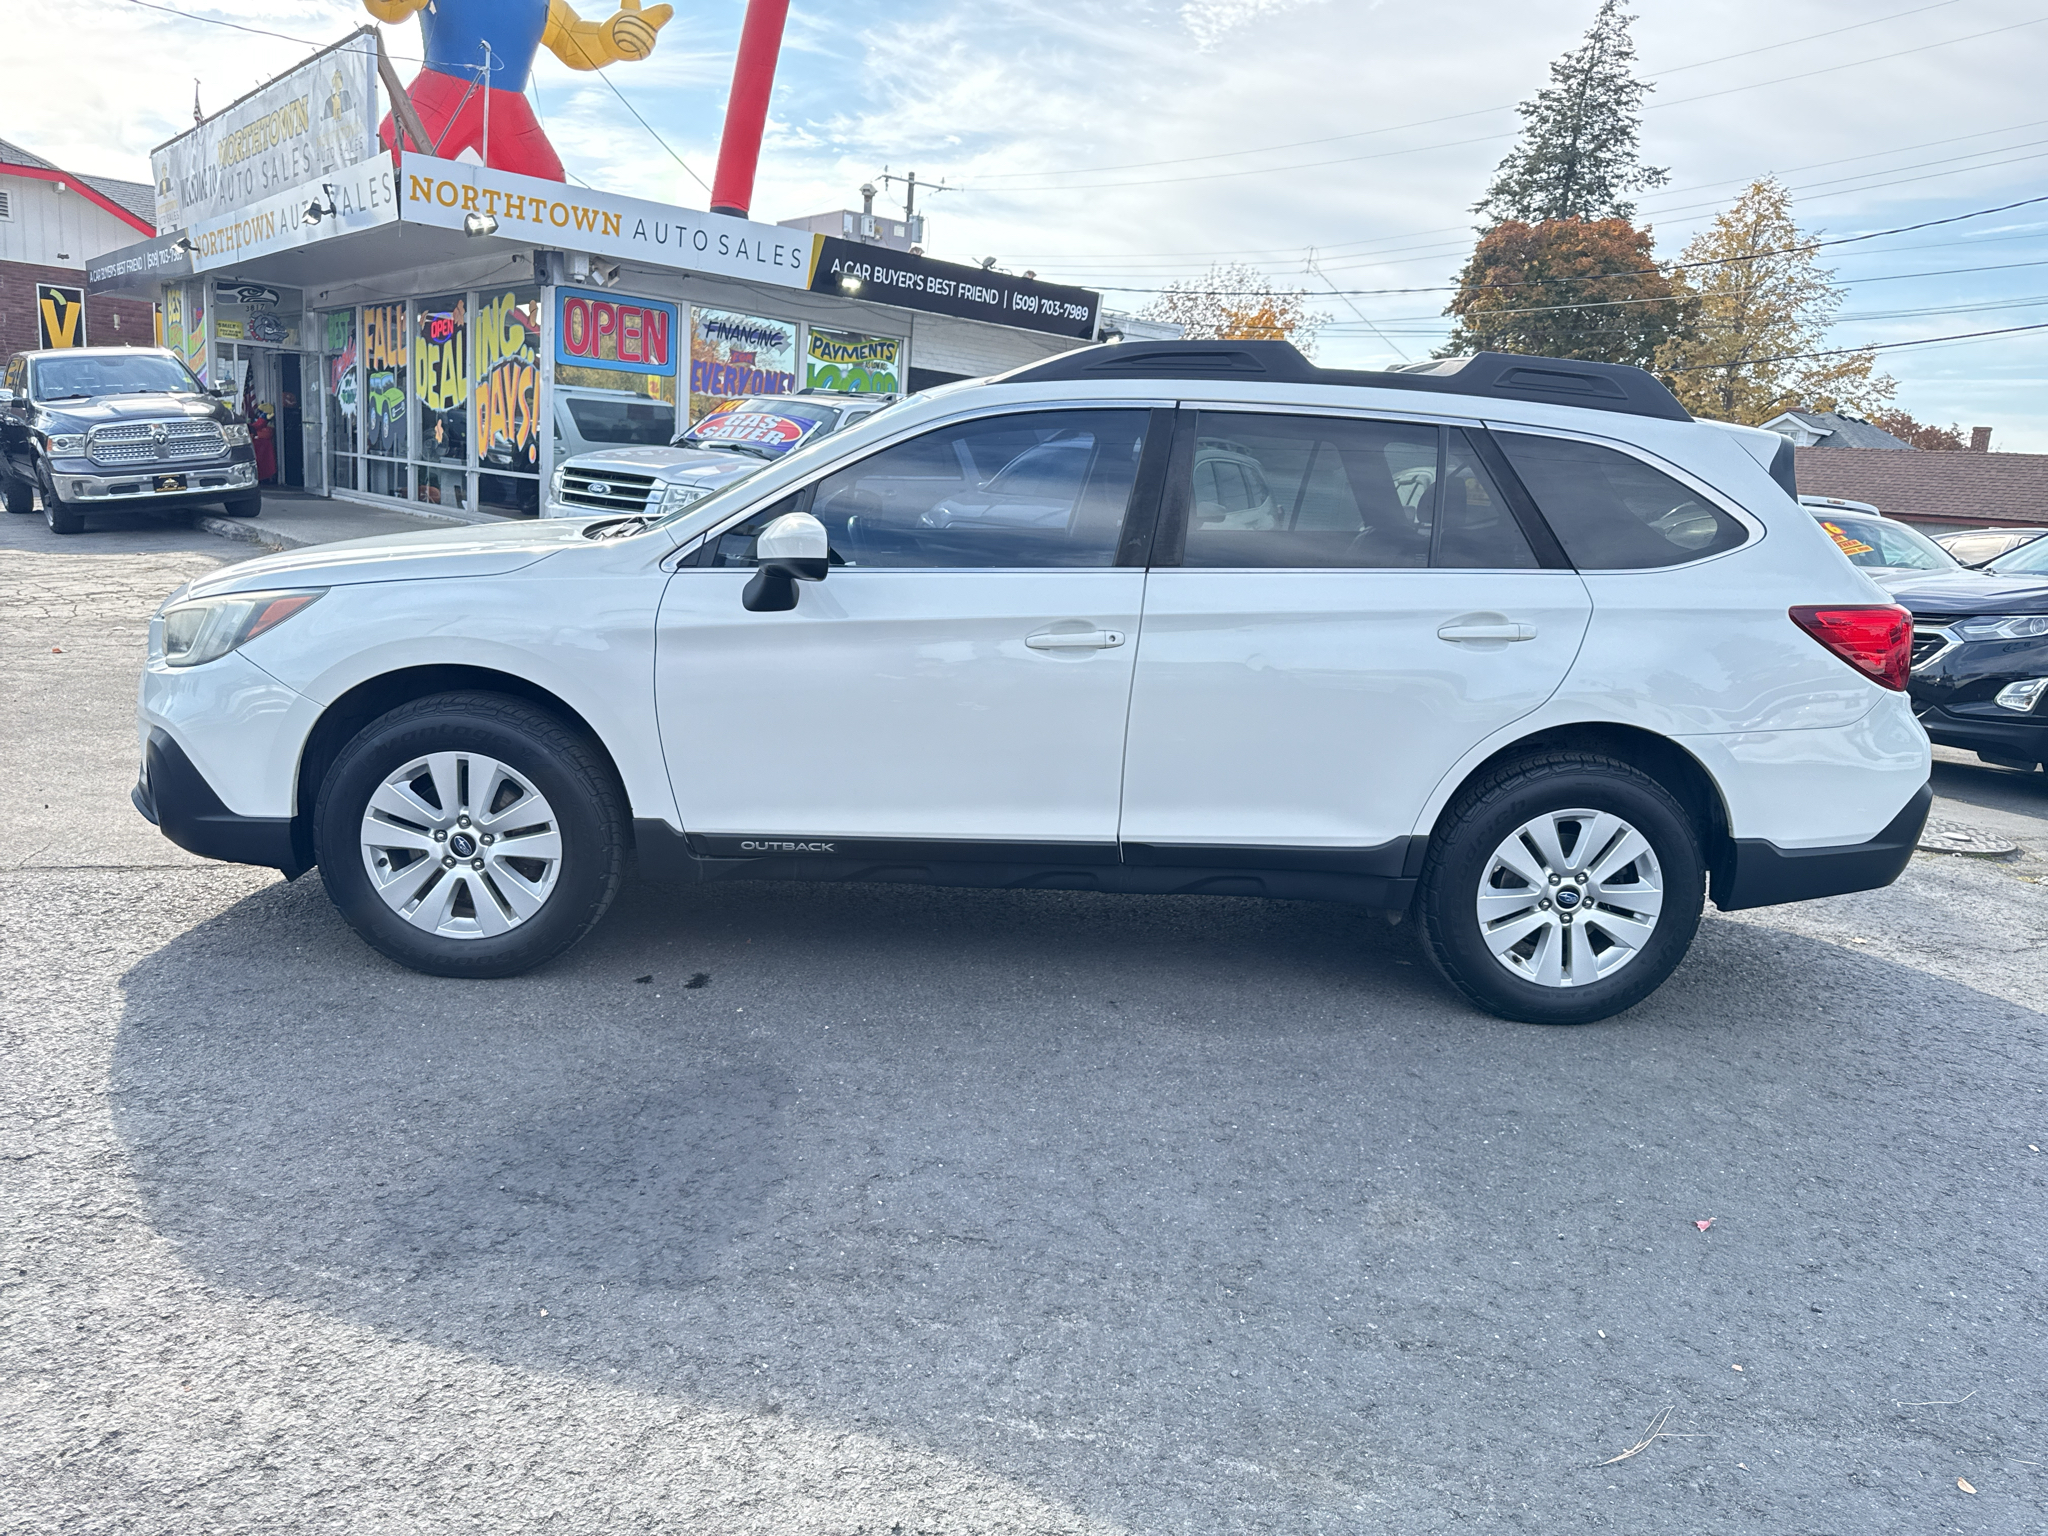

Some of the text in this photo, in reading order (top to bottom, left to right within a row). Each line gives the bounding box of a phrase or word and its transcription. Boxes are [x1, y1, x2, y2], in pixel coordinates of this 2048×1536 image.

[218, 94, 309, 171] NORTHTOWN
[219, 142, 310, 206] AUTO SALES
[194, 211, 275, 260] NORTHTOWN
[329, 172, 392, 219] ALES
[409, 174, 801, 269] NORTHTOWN AUTO SALES
[246, 304, 265, 312] 3817
[830, 258, 841, 274] A
[844, 261, 871, 280] CAR
[873, 266, 925, 291] BUYER'S
[926, 277, 957, 297] BEST
[958, 283, 999, 305] FRIEND
[1012, 292, 1039, 315] (509)
[1041, 299, 1089, 321] 703-7989
[363, 303, 407, 370] FALL
[430, 317, 454, 339] OPEN
[563, 297, 669, 365] OPEN
[705, 320, 784, 348] FINANCING
[812, 336, 895, 361] PAYMENTS
[415, 330, 467, 410] DEAL
[690, 358, 795, 396] EVERYONE!
[697, 425, 787, 445] SAVER
[723, 413, 783, 430] GAS
[740, 841, 834, 852] OUTBACK
